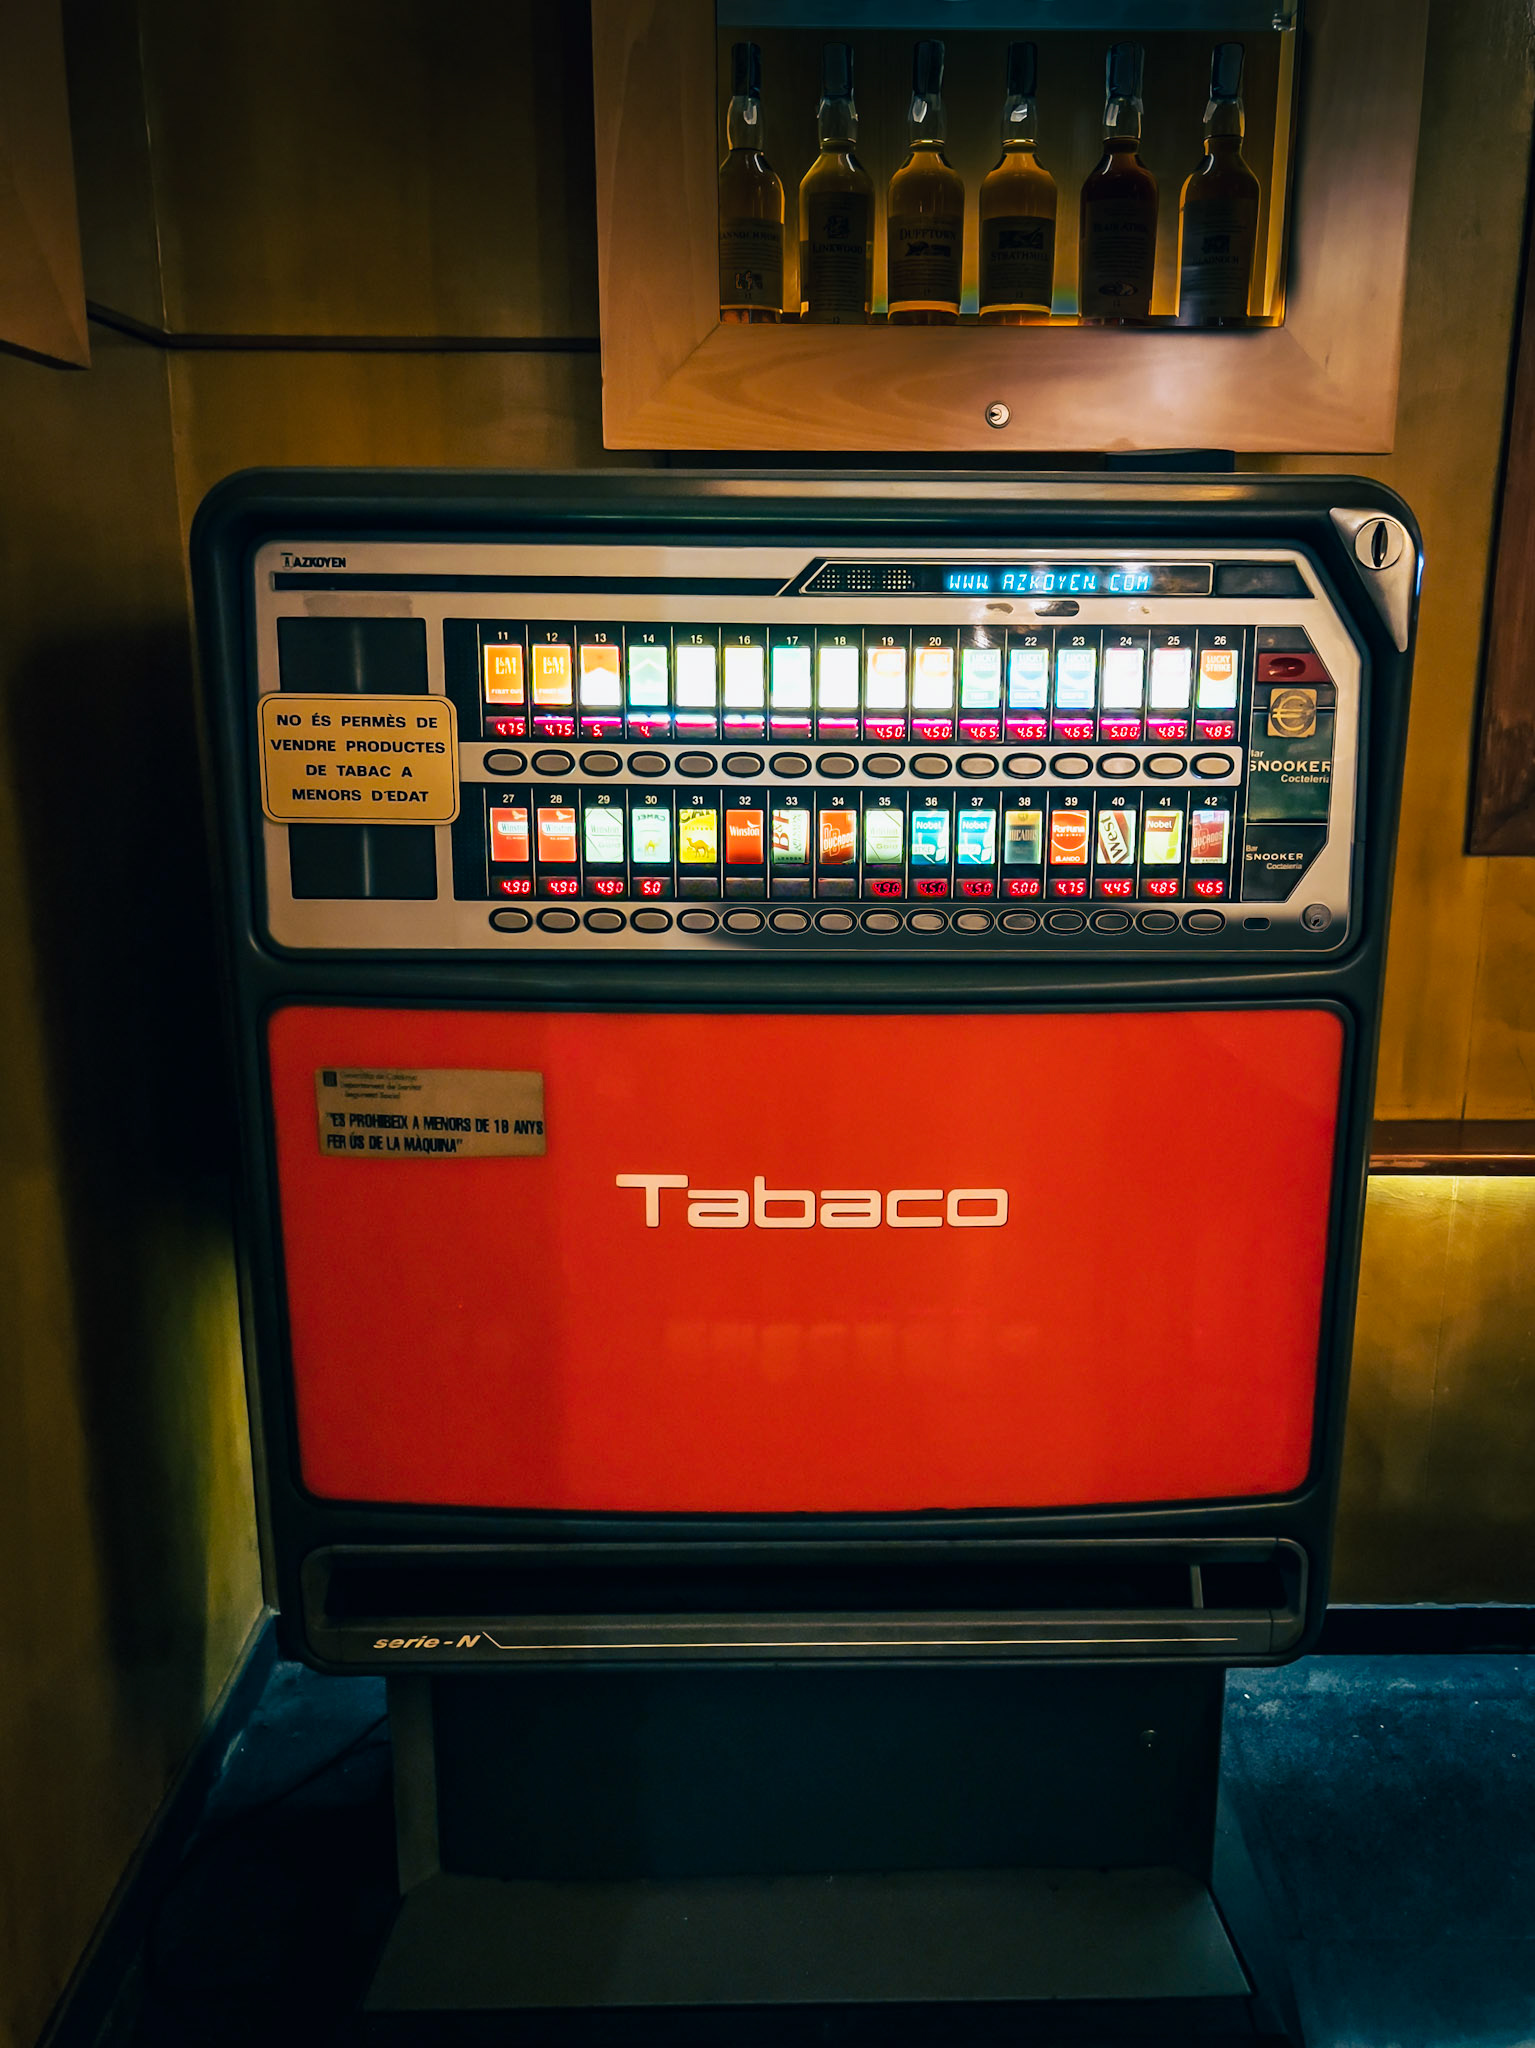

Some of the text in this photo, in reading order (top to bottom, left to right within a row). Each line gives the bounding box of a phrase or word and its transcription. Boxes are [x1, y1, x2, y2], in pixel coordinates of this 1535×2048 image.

[1002, 573, 1096, 591] AZKOYEN
[1109, 573, 1149, 591] COM
[498, 631, 508, 640] 11
[546, 633, 558, 642] 12
[595, 633, 607, 642] 13
[643, 634, 655, 643] 14
[690, 635, 703, 644] 15
[738, 635, 751, 645] 16
[786, 636, 799, 645] 17
[834, 636, 846, 645] 18
[1214, 636, 1227, 645] 26
[882, 637, 894, 646] 19
[929, 637, 941, 646] 20
[1025, 637, 1037, 646] 22
[1072, 636, 1084, 646] 23
[1120, 636, 1132, 646] 24
[1168, 636, 1180, 646] 25
[1206, 655, 1231, 664] LUCKY
[1205, 663, 1231, 673] STRIKE
[276, 712, 437, 728] NO ÉS PERMÈS DE
[496, 722, 525, 735] 4.75
[545, 723, 572, 735] 4.75
[1205, 725, 1232, 738] 4.85
[270, 739, 446, 753] VENDRE PRODUCTES
[306, 764, 413, 777] DE TABAC A
[1250, 760, 1330, 773] SNOOKER
[292, 788, 429, 802] MENORS D'EDAT
[503, 794, 515, 803] 27
[550, 794, 562, 804] 28
[598, 795, 610, 804] 29
[645, 795, 657, 804] 30
[692, 796, 704, 805] 31
[739, 796, 751, 805] 32
[786, 796, 798, 806] 33
[832, 796, 844, 806] 34
[878, 797, 891, 806] 35
[925, 797, 938, 806] 36
[971, 797, 983, 806] 37
[1018, 797, 1031, 806] 38
[1065, 797, 1078, 806] 39
[1111, 797, 1125, 806] 40
[1159, 797, 1171, 806] 41
[1204, 796, 1218, 806] 42
[916, 820, 942, 830] Nobel
[962, 820, 988, 830] Nobel
[1053, 825, 1085, 833] Fortuna
[1147, 820, 1173, 829] Nobel
[729, 825, 760, 836] Winston
[823, 831, 854, 852] DUCADOS
[1100, 816, 1123, 859] West
[1193, 831, 1223, 848] DUCADOS
[1245, 853, 1304, 861] SNOOKER
[502, 881, 530, 893] 4.90
[550, 881, 578, 893] 4.90
[597, 881, 624, 893] 4.90
[1011, 882, 1039, 894] 5.00
[1058, 881, 1084, 894] 4.75
[1103, 881, 1131, 894] 4.45
[1150, 881, 1177, 894] 4.85
[1197, 881, 1224, 894] 4.65
[350, 1113, 408, 1129] PROHIBEIX
[412, 1116, 419, 1129] A
[423, 1116, 471, 1132] MENORS
[475, 1118, 489, 1133] DE
[494, 1119, 509, 1134] 18
[514, 1120, 544, 1135] ANYS
[327, 1134, 345, 1149] FER
[350, 1132, 365, 1149] ÚS
[369, 1135, 383, 1150] DE
[386, 1136, 400, 1151] LA
[615, 1173, 1009, 1228] Tabaco
